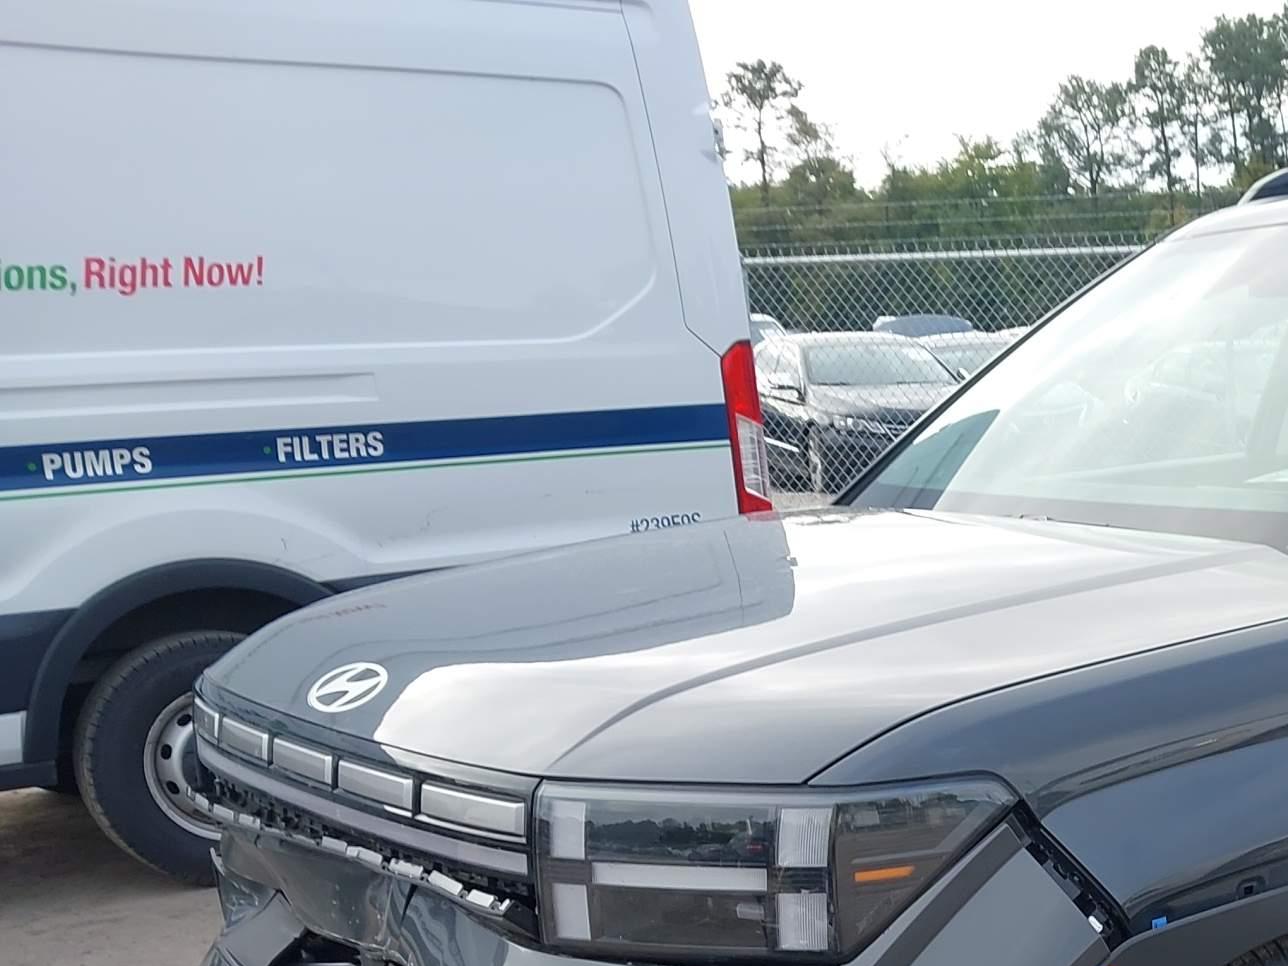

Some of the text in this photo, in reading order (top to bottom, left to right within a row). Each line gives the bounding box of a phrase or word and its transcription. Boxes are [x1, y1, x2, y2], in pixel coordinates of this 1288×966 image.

[84, 256, 172, 296] Right
[183, 256, 263, 287] Now!
[41, 431, 385, 480] PUMPS FILTERS
